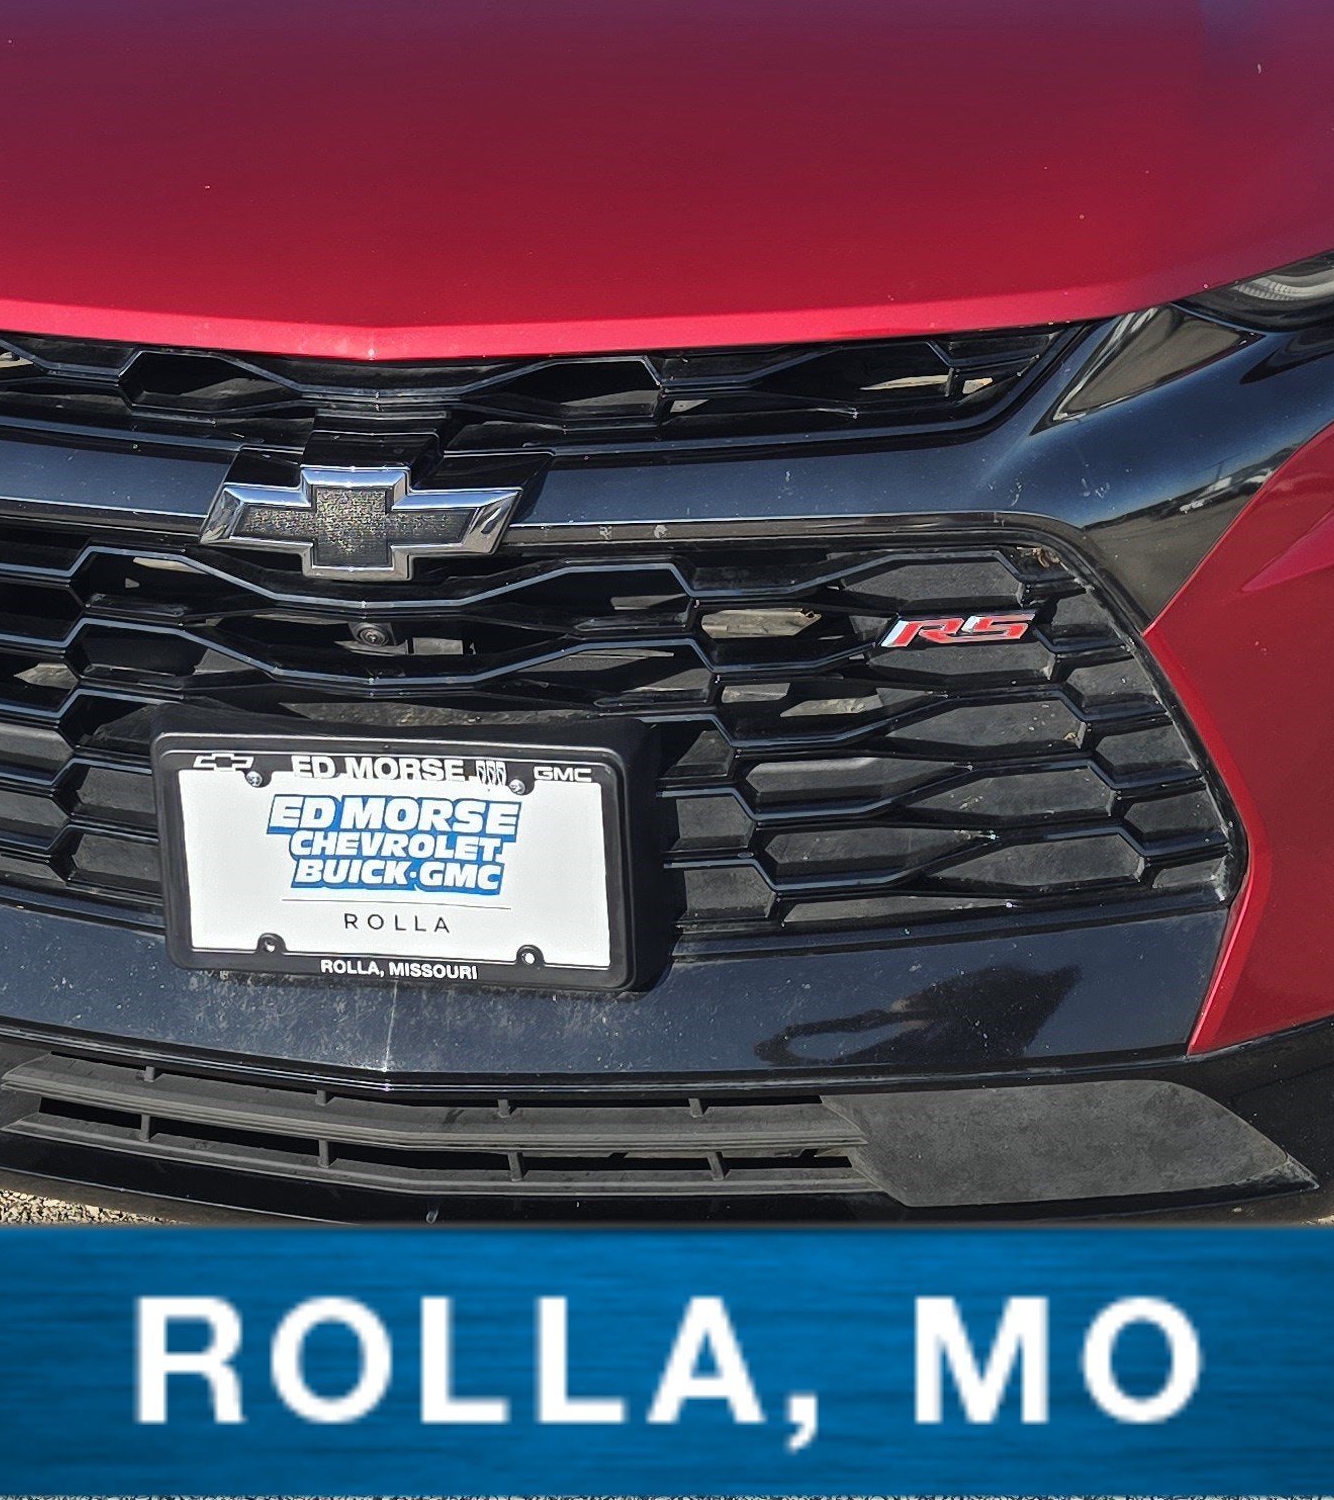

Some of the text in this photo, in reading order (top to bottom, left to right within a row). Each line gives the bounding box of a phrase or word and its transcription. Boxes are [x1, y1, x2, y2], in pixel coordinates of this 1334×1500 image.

[880, 611, 1036, 648] RS
[291, 755, 466, 783] ED MORSE
[533, 765, 593, 784] GMC
[269, 797, 521, 837] ED MORSE
[290, 830, 503, 863] CHEVROLET
[343, 912, 452, 934] ROLLA
[319, 959, 479, 981] ROLLA, MISSOURI
